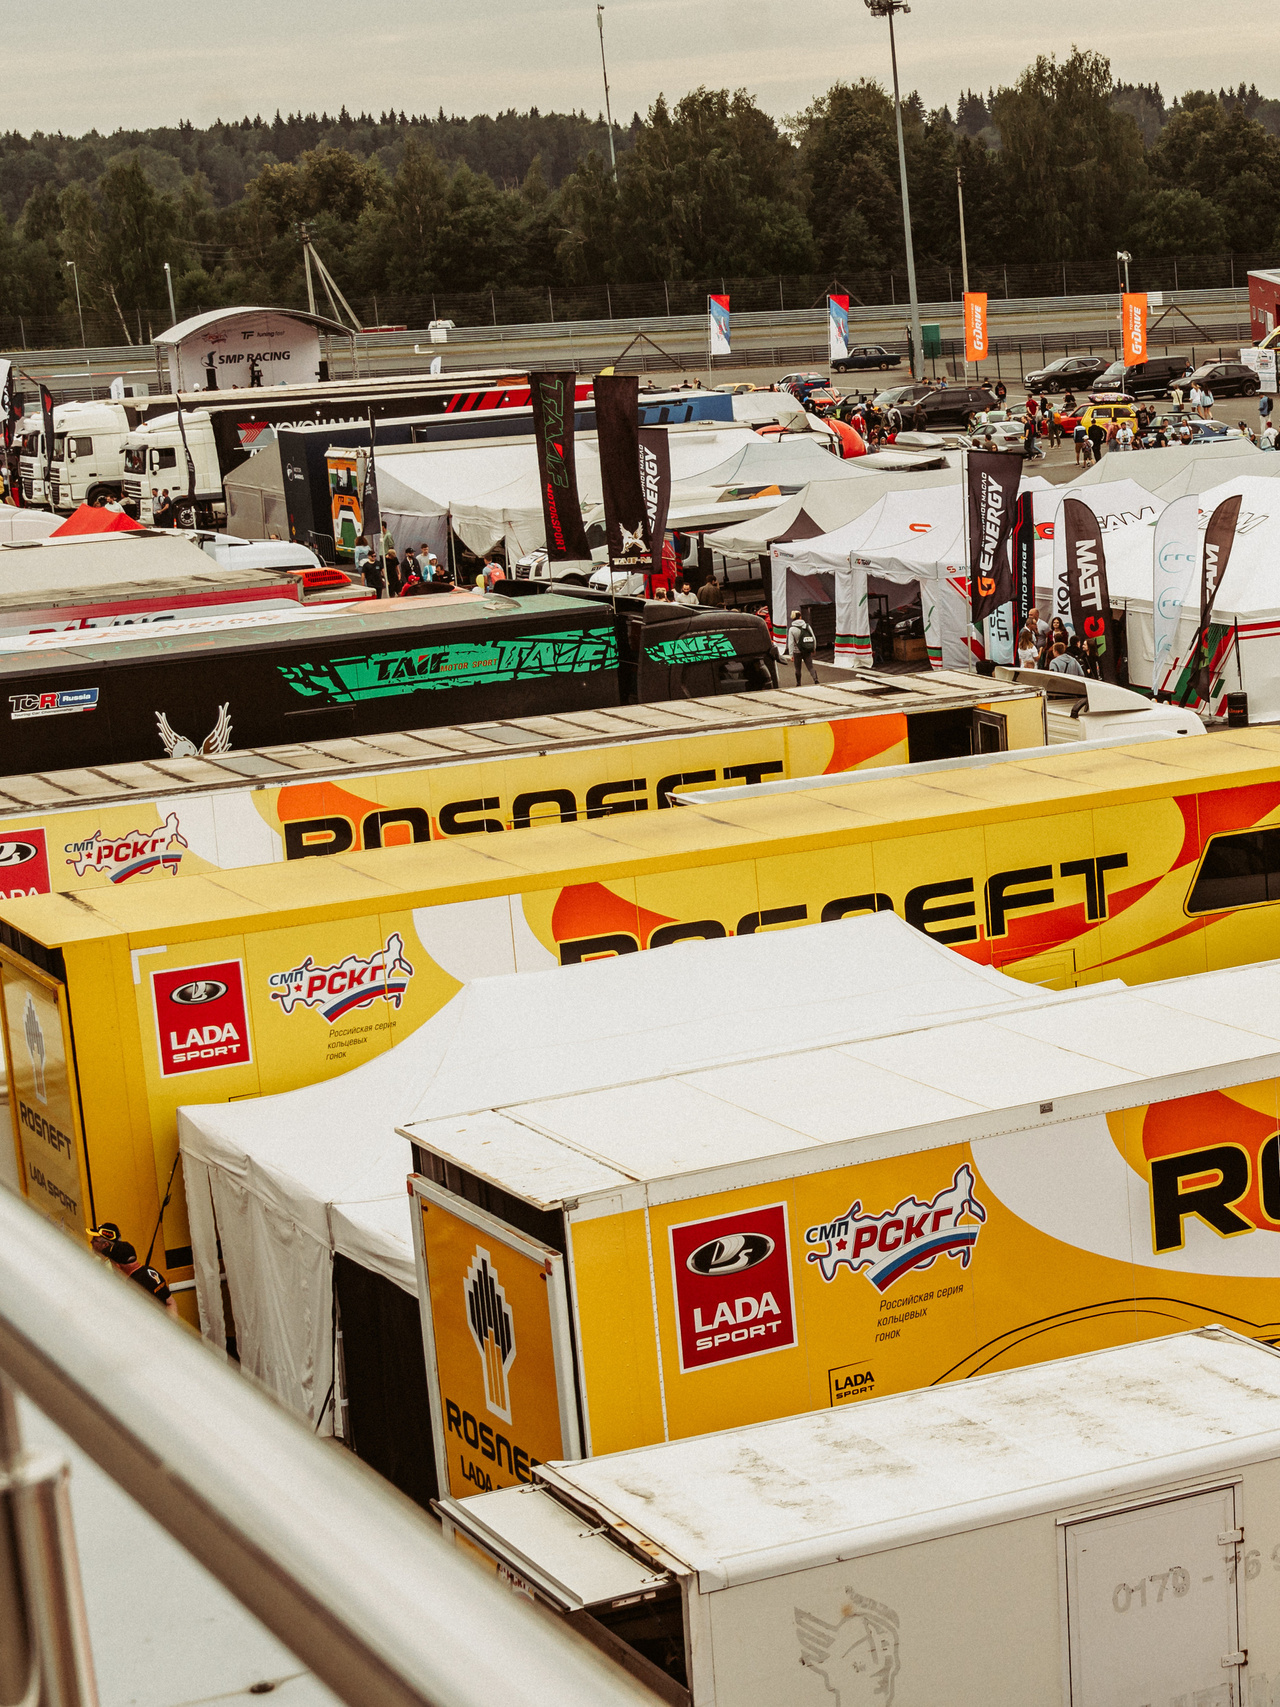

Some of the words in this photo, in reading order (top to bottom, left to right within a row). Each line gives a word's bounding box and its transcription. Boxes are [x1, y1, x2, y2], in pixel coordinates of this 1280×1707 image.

[218, 354, 244, 364] SMP
[246, 351, 290, 362] RACING
[547, 483, 566, 552] MOTORSPORT
[440, 661, 470, 674] MOTOR
[472, 658, 498, 670] SPORT
[9, 692, 58, 713] TCR
[62, 694, 91, 702] Russia
[64, 841, 94, 853] СМП
[96, 838, 166, 865] РСКГ
[270, 970, 304, 986] СМП
[306, 964, 388, 998] РСКГ
[170, 1022, 240, 1050] LADA
[328, 1036, 368, 1049] кольцевых
[329, 1025, 372, 1038] Российская
[374, 1020, 396, 1032] серия
[172, 1042, 241, 1064] SPORT
[326, 1052, 346, 1061] гонок
[20, 1100, 72, 1160] ROSNEFT
[30, 1162, 47, 1191] LADA
[47, 1180, 78, 1216] SPORT
[806, 1220, 850, 1244] СМП
[852, 1206, 954, 1259] РСКГ
[693, 1290, 782, 1333] LADA
[879, 1292, 932, 1314] Российская
[936, 1282, 964, 1302] серия
[876, 1306, 928, 1328] кольцевых
[696, 1320, 782, 1352] SPORT
[874, 1328, 902, 1342] гонок
[834, 1370, 876, 1392] LADA
[836, 1382, 876, 1402] SPORT
[460, 1455, 492, 1492] LADA
[1112, 1566, 1191, 1613] 0179
